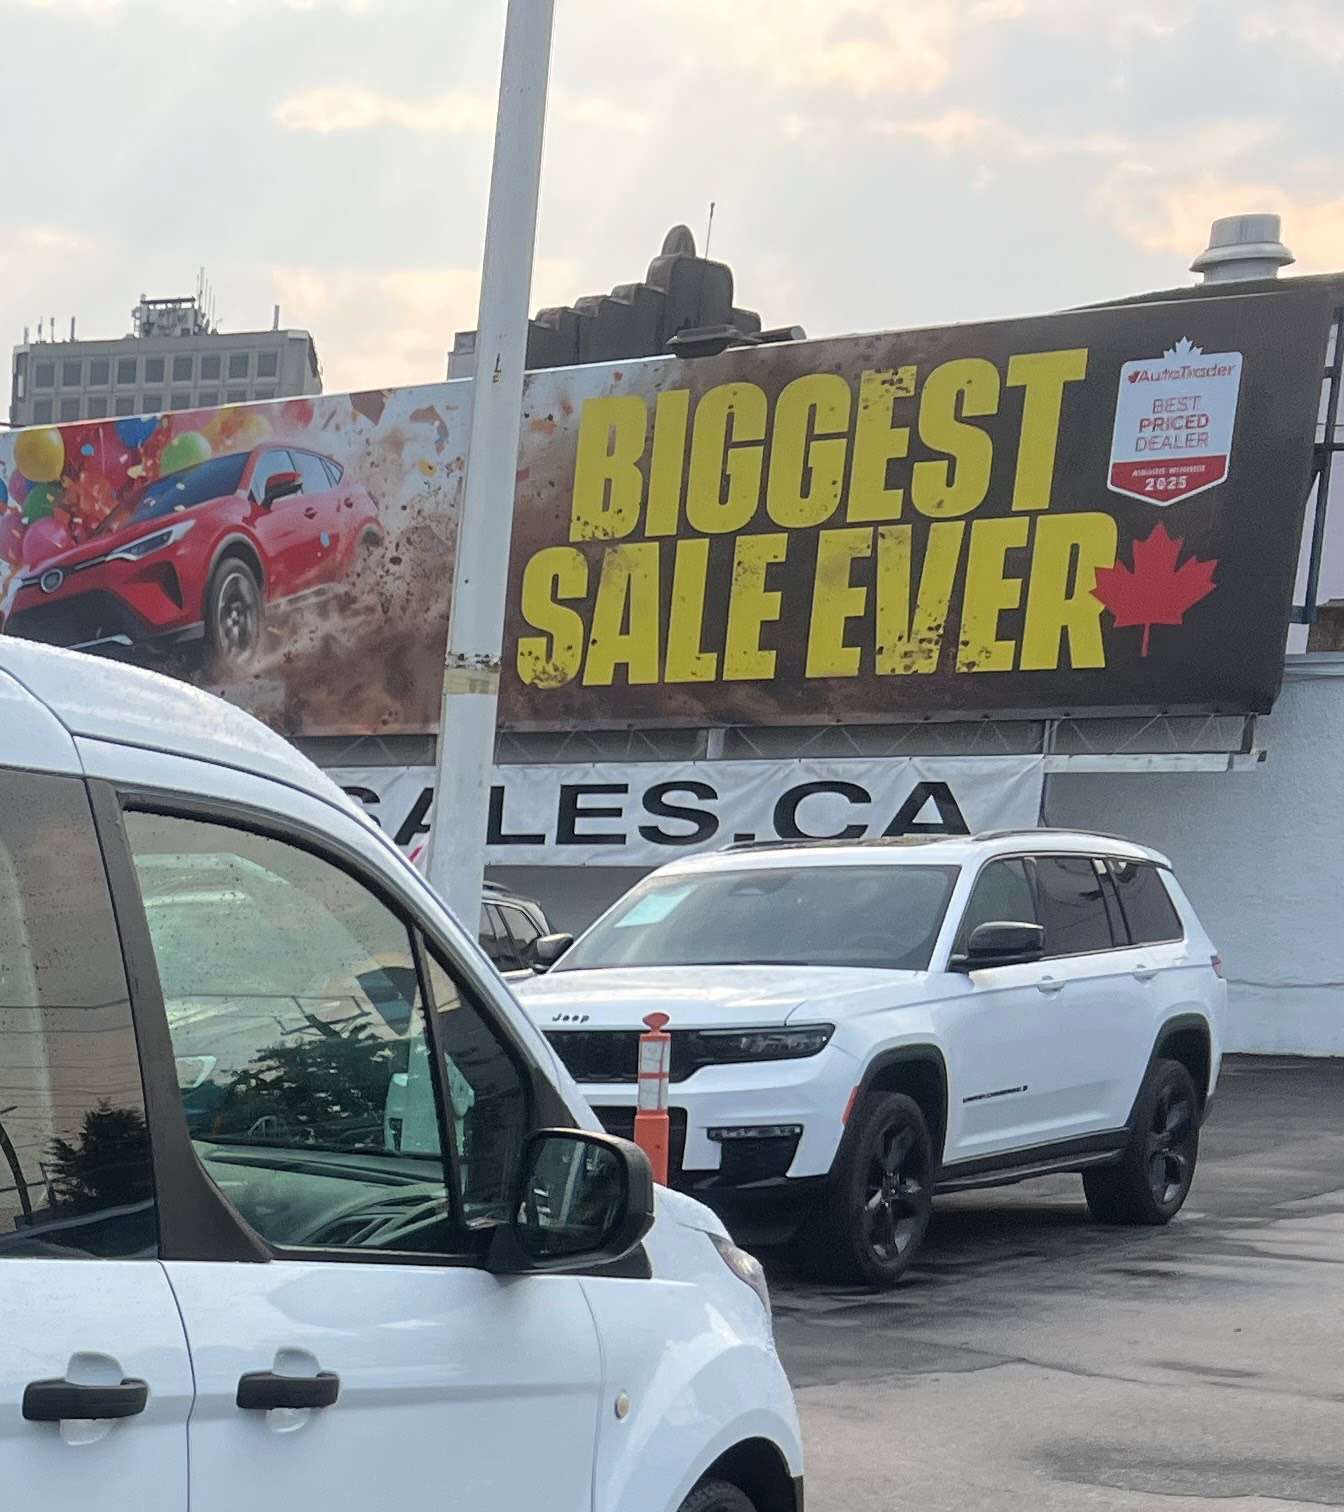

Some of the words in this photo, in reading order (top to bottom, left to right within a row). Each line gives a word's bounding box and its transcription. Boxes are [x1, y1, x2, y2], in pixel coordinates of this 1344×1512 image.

[1138, 363, 1235, 384] AutoTrader
[1152, 395, 1201, 414] BEST
[1138, 413, 1209, 433] PRICED
[569, 348, 1089, 543] BIGGEST
[1135, 431, 1209, 452] DEALER
[1145, 475, 1189, 491] 2025
[517, 533, 789, 690] SALE
[806, 512, 1118, 678] EVER
[340, 780, 971, 845] LES.CA
[552, 1012, 590, 1024] Jeep
